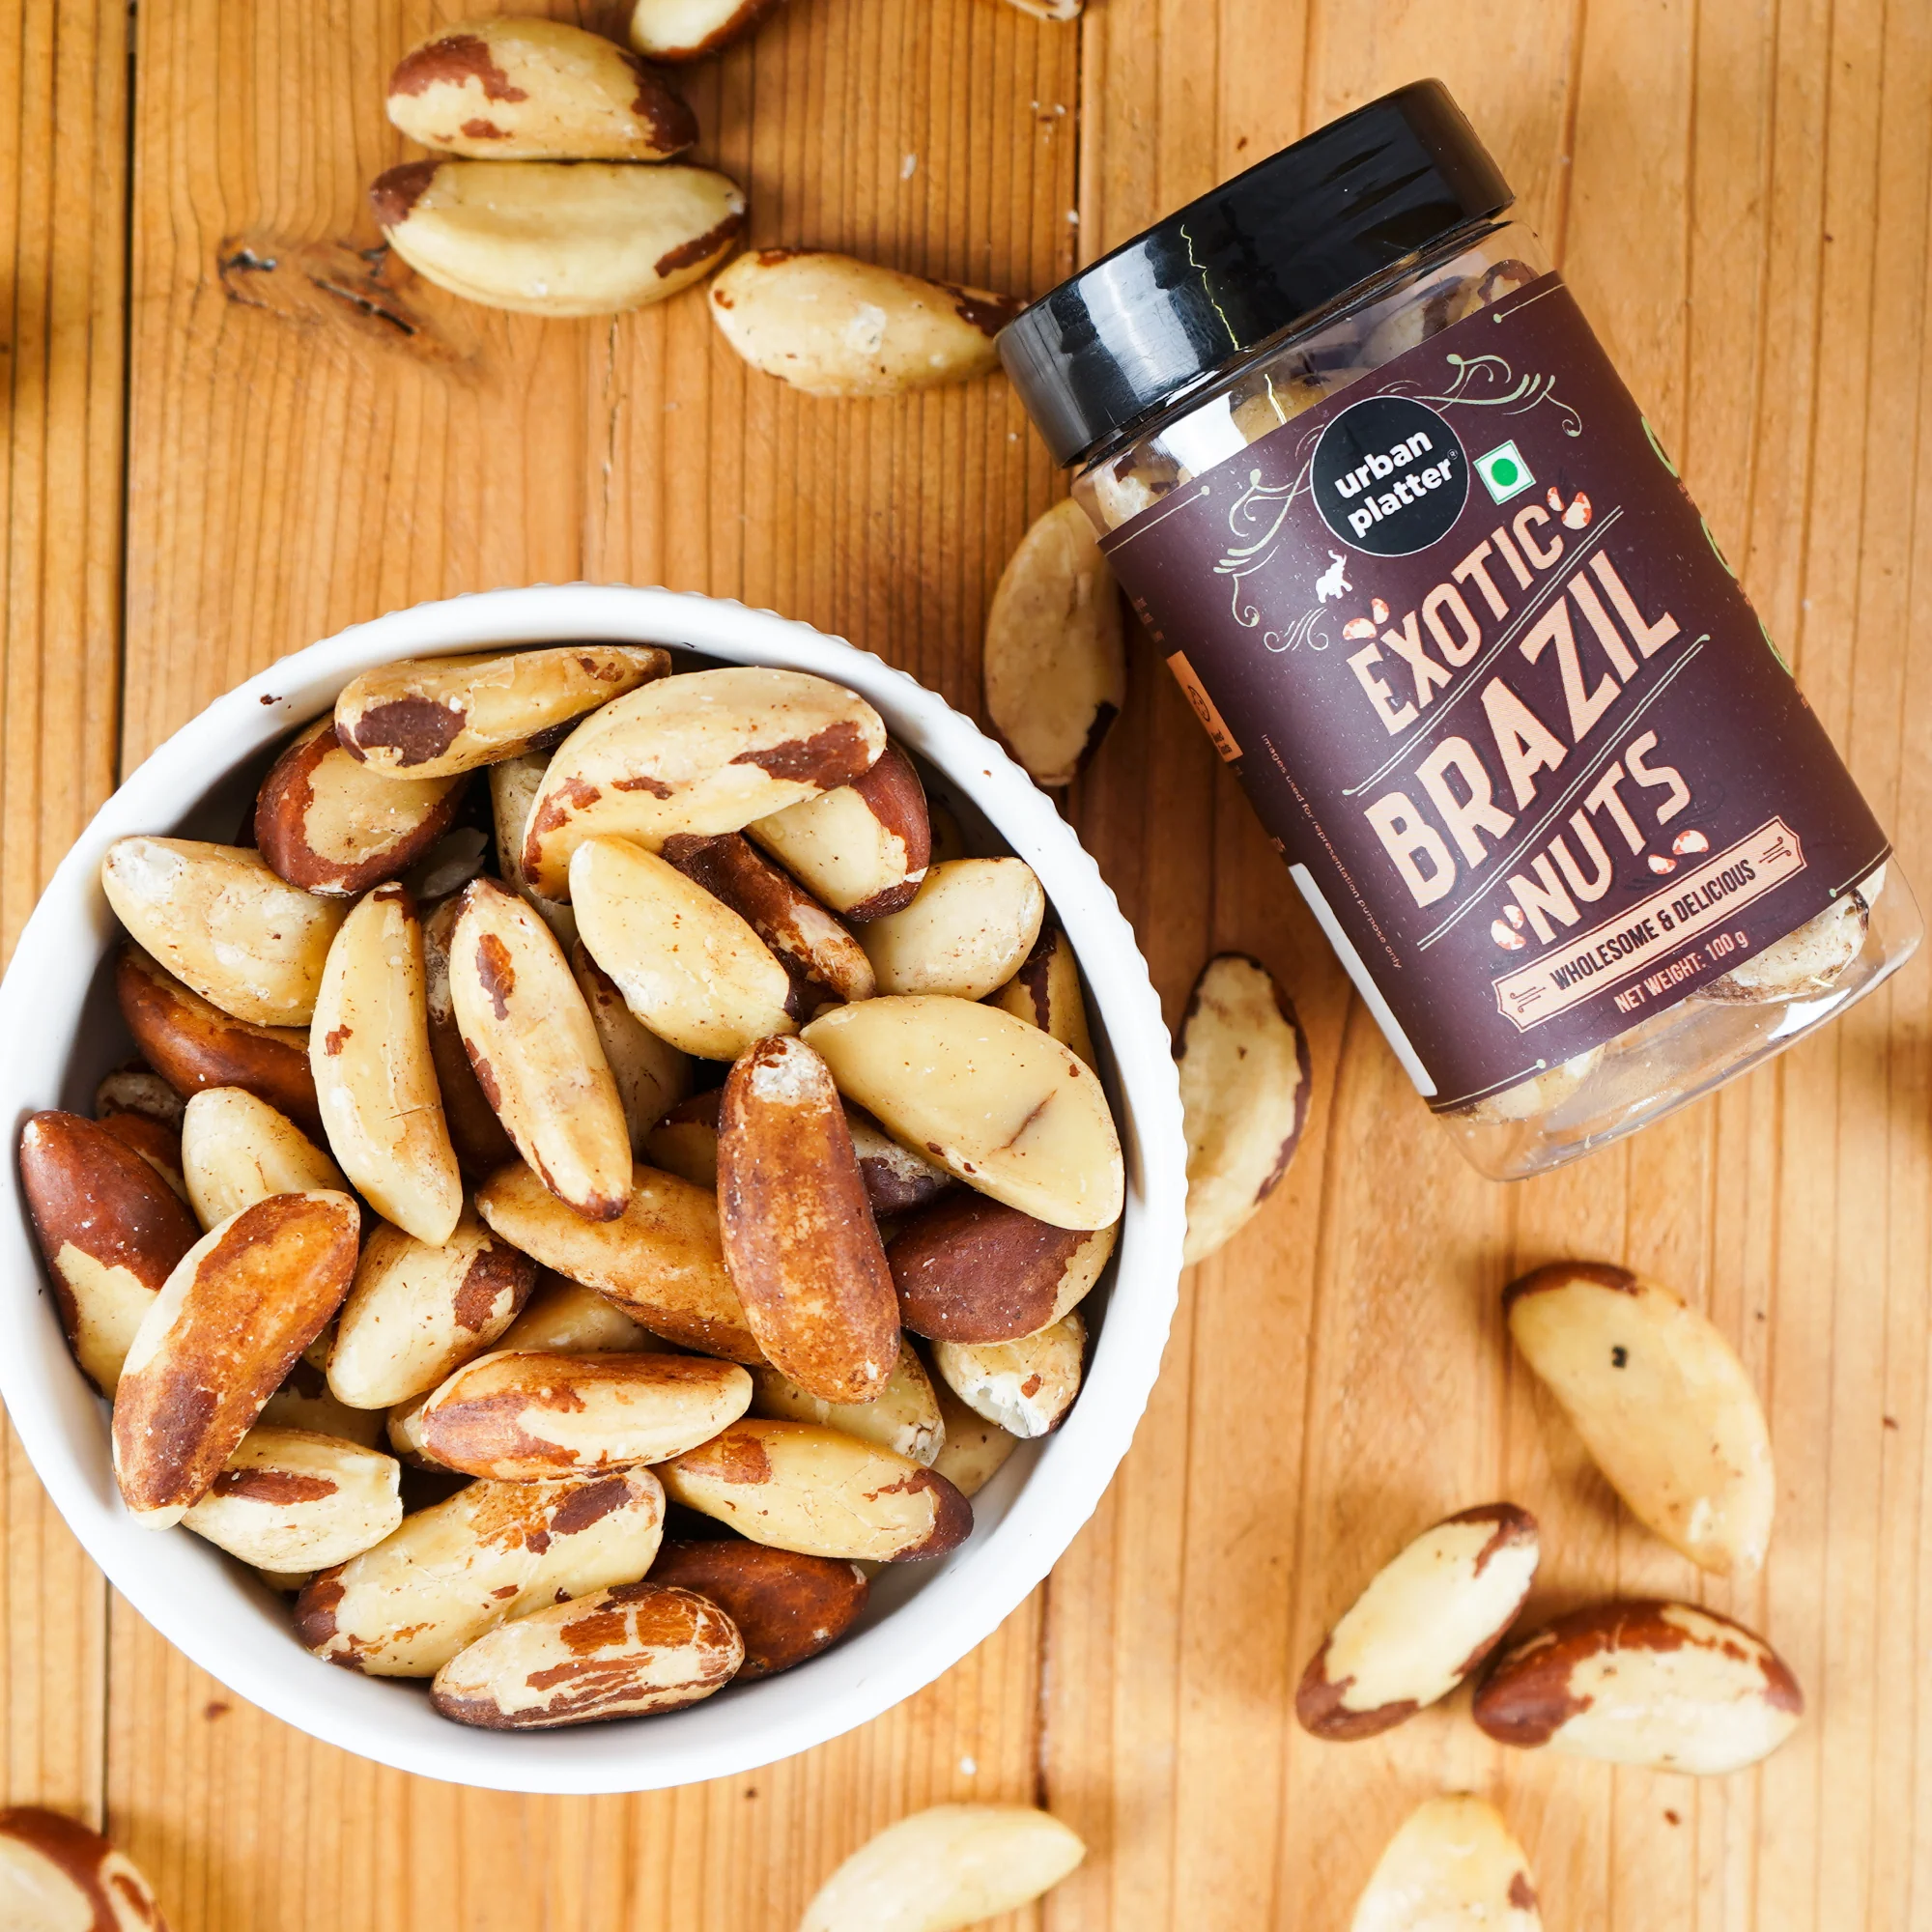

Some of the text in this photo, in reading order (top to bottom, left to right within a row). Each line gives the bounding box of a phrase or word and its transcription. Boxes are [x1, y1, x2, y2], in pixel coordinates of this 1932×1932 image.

[1334, 432, 1434, 498] urban
[1347, 504, 1565, 737] EXOTIC
[1364, 550, 1681, 909] BRAZIL
[1261, 733, 1403, 969] Images used for representation purpose only
[1507, 730, 1691, 946] NUTS
[1549, 859, 1756, 990] WHOLESOME & DELICIOUS
[1613, 930, 1749, 1014] NET WEIGHT: 100 g
